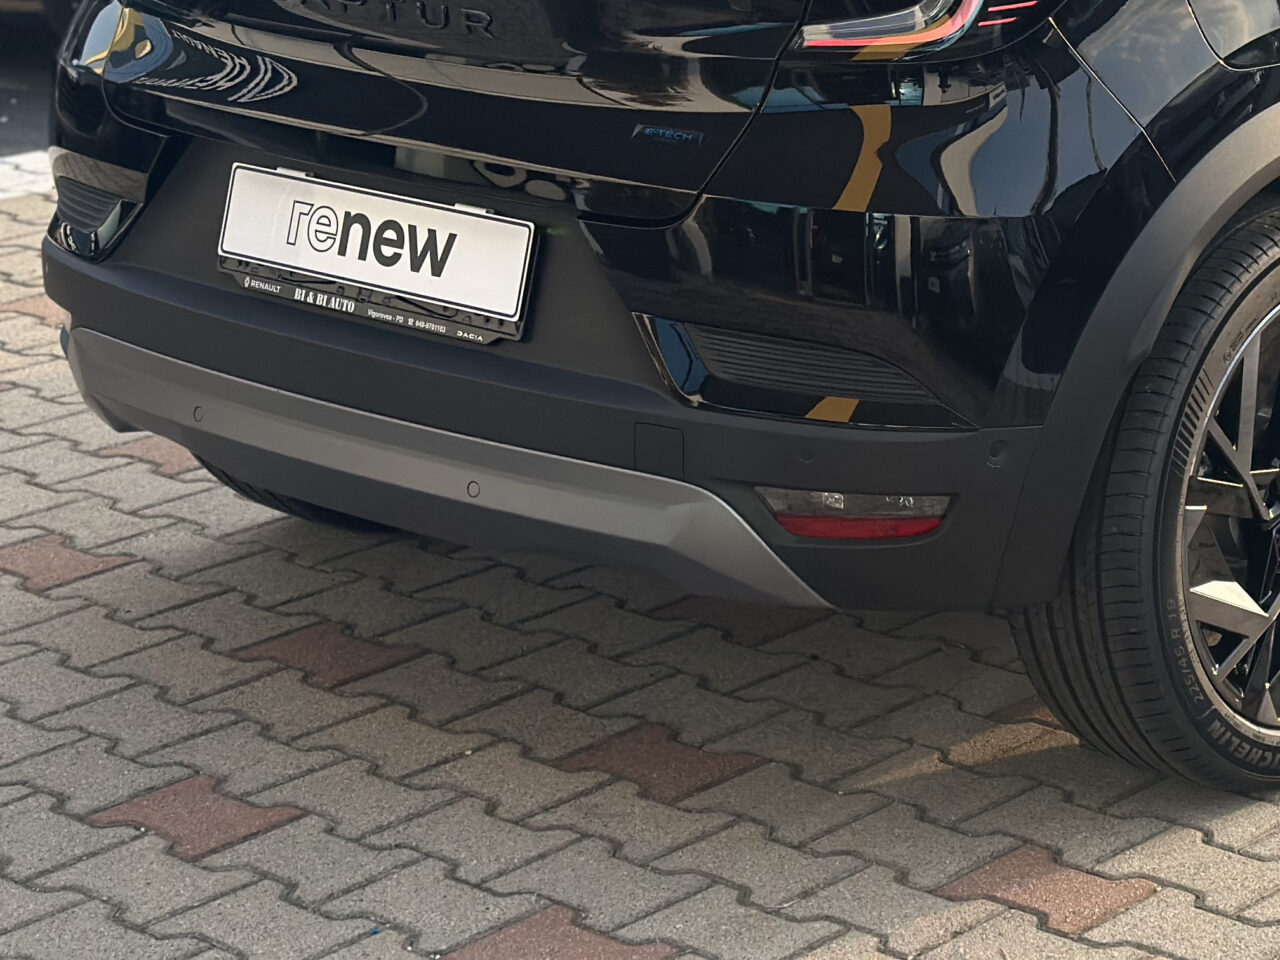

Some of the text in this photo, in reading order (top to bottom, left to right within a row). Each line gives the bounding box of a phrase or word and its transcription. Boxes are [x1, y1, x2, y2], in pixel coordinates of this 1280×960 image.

[286, 199, 458, 278] renew
[250, 279, 281, 293] RENAULT
[293, 287, 355, 313] BI & BI AUTO
[456, 330, 483, 342] DACIA
